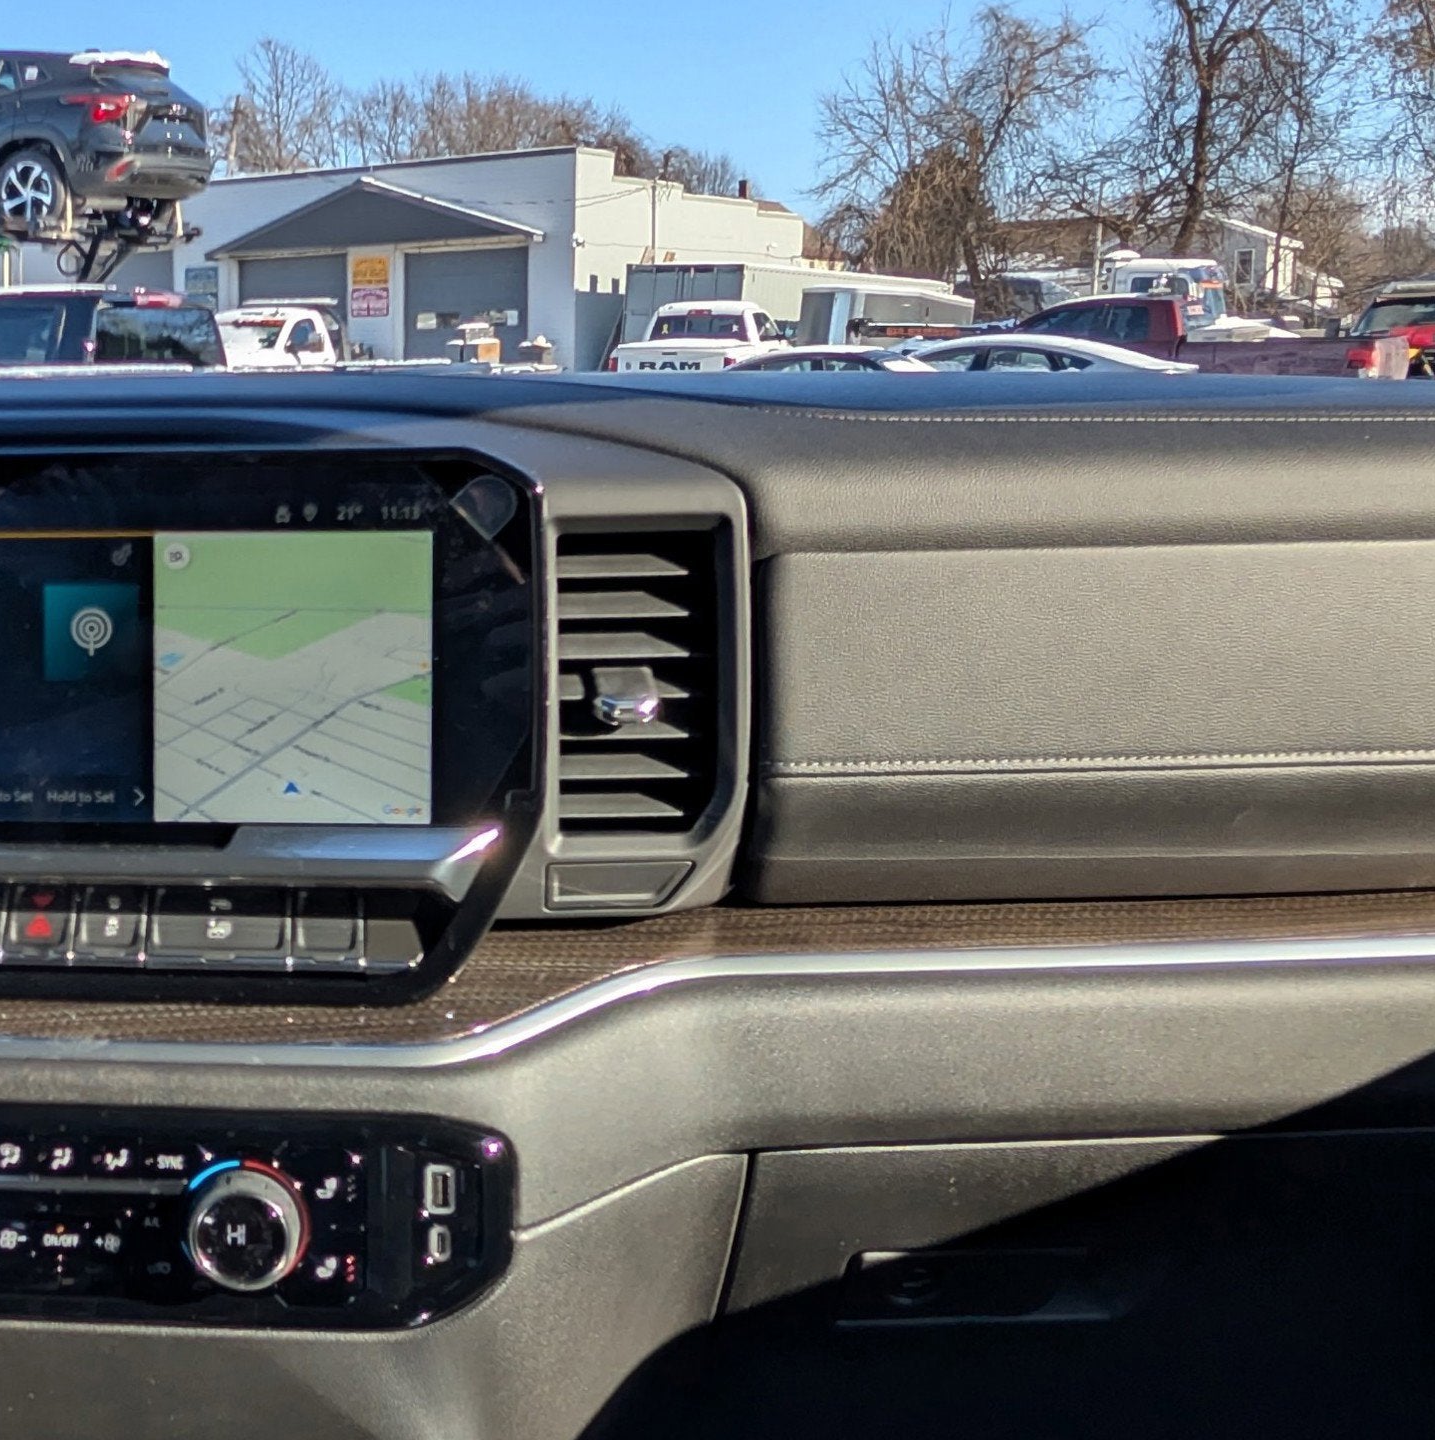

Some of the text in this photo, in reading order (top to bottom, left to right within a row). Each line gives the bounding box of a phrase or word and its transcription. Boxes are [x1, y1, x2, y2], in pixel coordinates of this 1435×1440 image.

[638, 361, 701, 371] RAM
[13, 788, 34, 803] Set
[47, 788, 76, 803] Hold
[94, 789, 115, 804] Set
[157, 1154, 185, 1170] SYNC
[226, 1224, 247, 1247] HI
